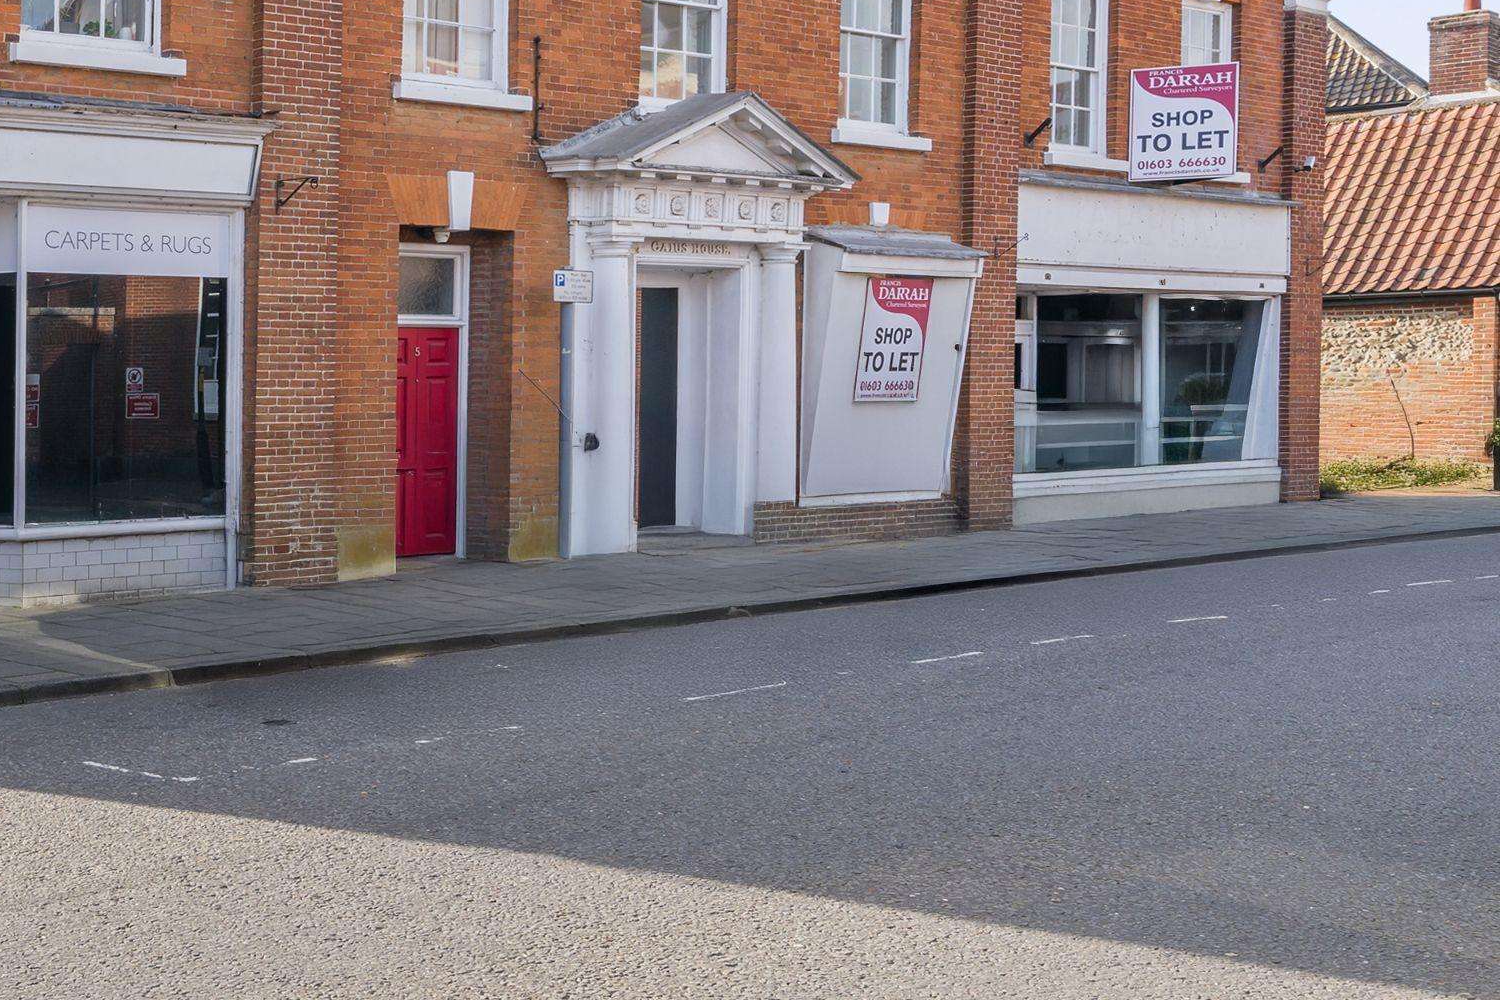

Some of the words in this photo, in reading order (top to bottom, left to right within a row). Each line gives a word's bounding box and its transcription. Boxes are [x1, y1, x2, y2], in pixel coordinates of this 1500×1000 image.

[1149, 69, 1184, 77] FRANCIS
[1149, 71, 1233, 89] DARRAH
[1151, 109, 1213, 128] SHOP
[1137, 133, 1172, 153] TO
[1182, 130, 1229, 150] LET
[1137, 159, 1172, 170] 01603
[1179, 156, 1226, 167] 666630
[44, 230, 134, 252] CARPETS
[140, 234, 154, 252] &
[161, 235, 212, 255] RUGS
[691, 243, 731, 255] HOUSE
[556, 274, 564, 286] P
[878, 287, 929, 300] DARRAH
[874, 327, 912, 344] SHOP
[864, 351, 885, 372] TO
[889, 351, 919, 372] LET
[860, 380, 882, 391] 01603
[884, 380, 914, 391] 666630
